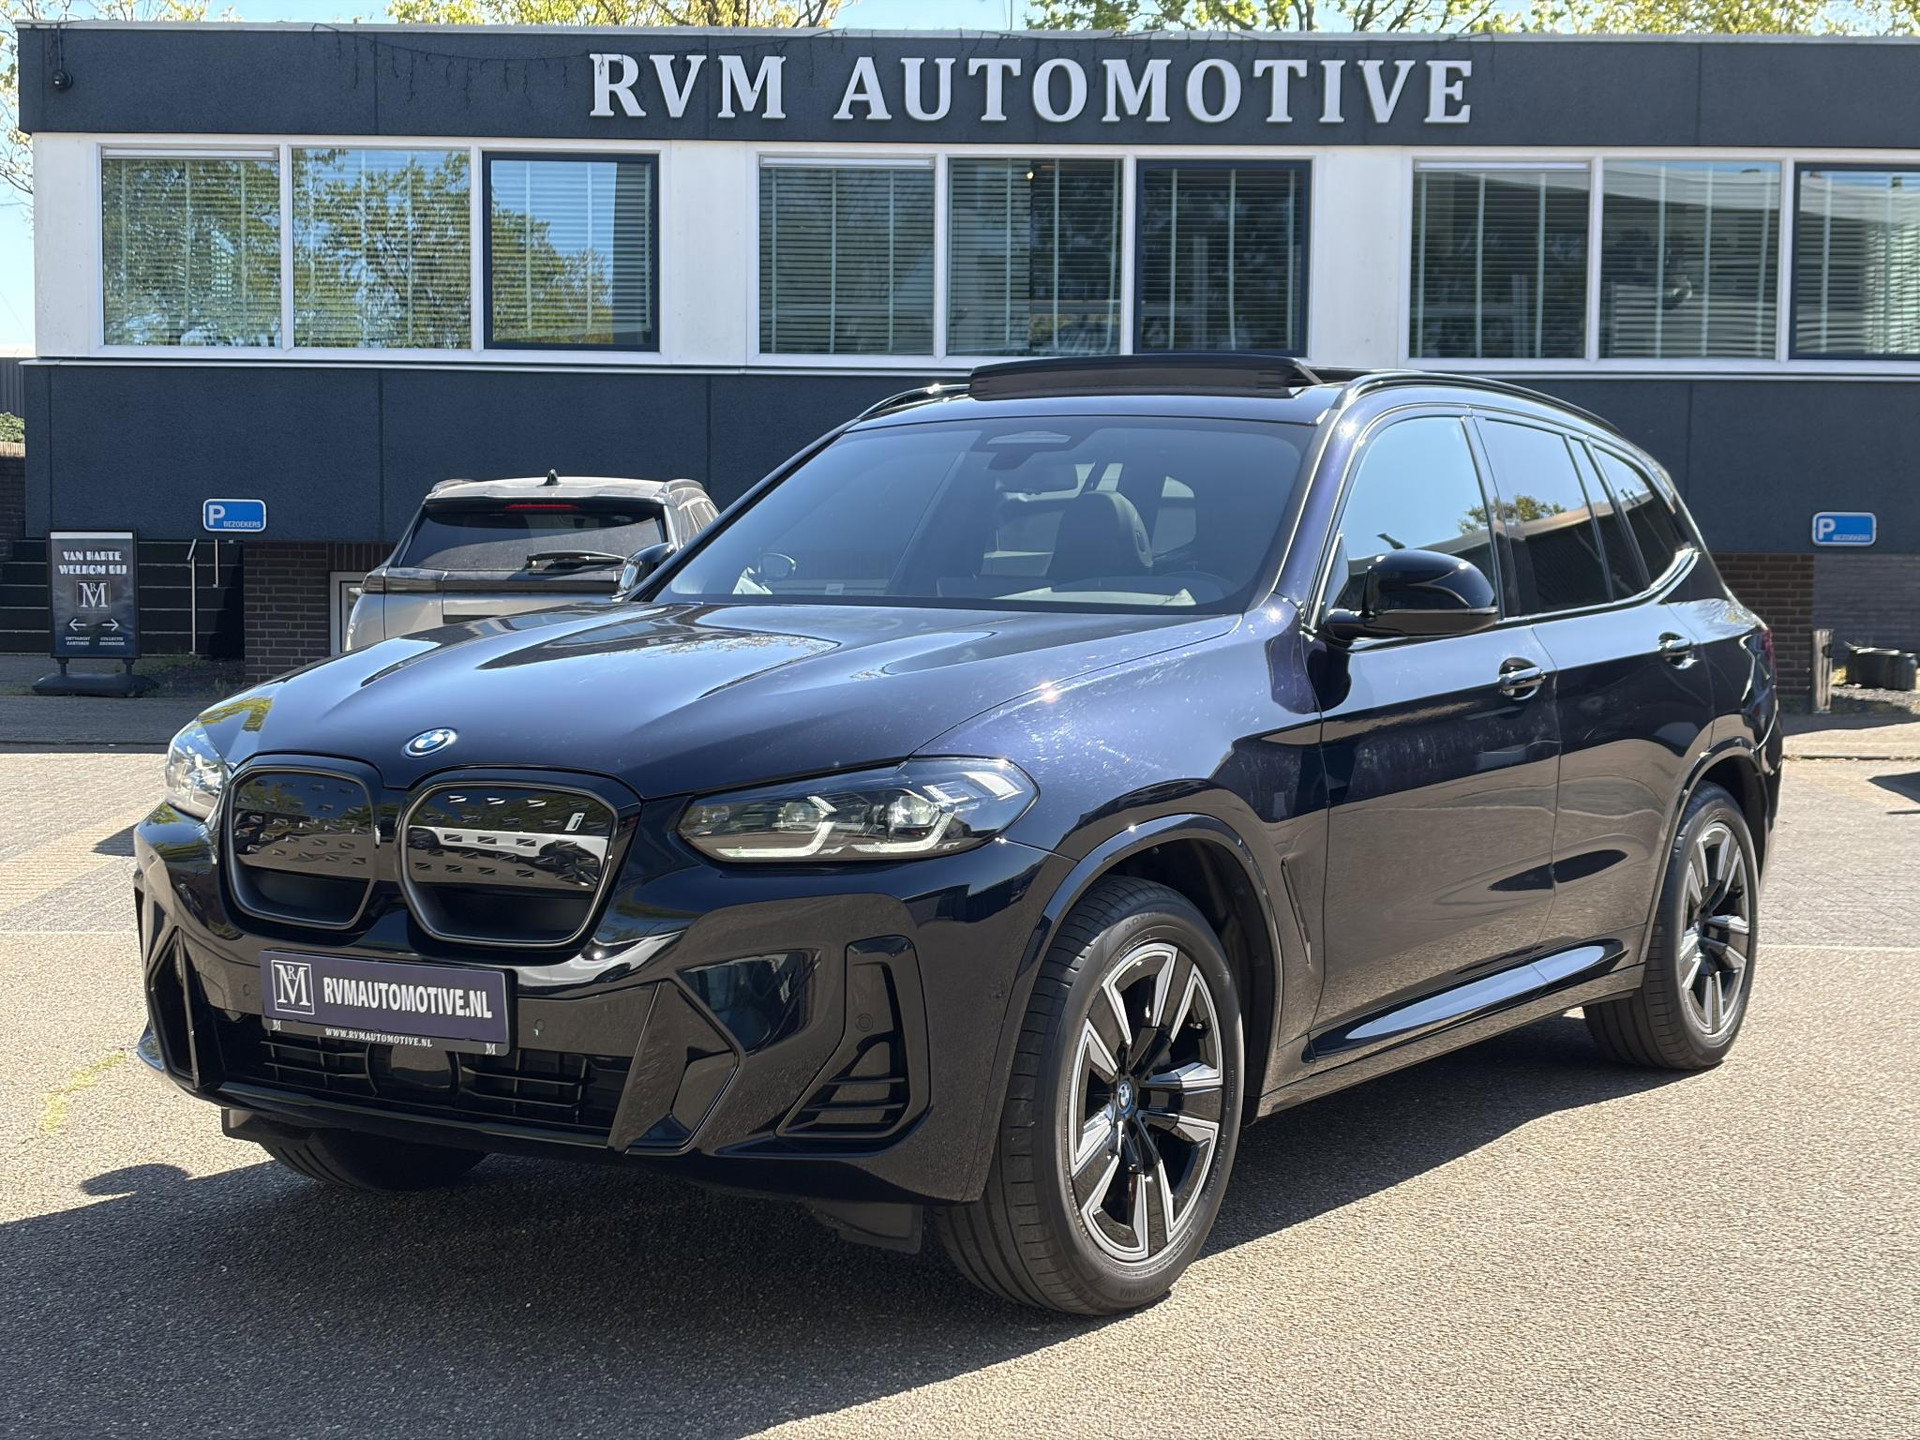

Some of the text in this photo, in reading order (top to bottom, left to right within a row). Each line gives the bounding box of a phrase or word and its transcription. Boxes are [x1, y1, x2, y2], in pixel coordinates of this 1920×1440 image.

[589, 53, 1473, 124] RVM AUTOMOTIVE
[208, 504, 226, 526] P
[1817, 518, 1836, 540] P
[62, 550, 84, 561] VAN
[323, 977, 493, 1019] RVMAUTOMOTIVE.NL
[325, 1027, 433, 1048] WWW.RVMAUTOMOTIVE.NL
